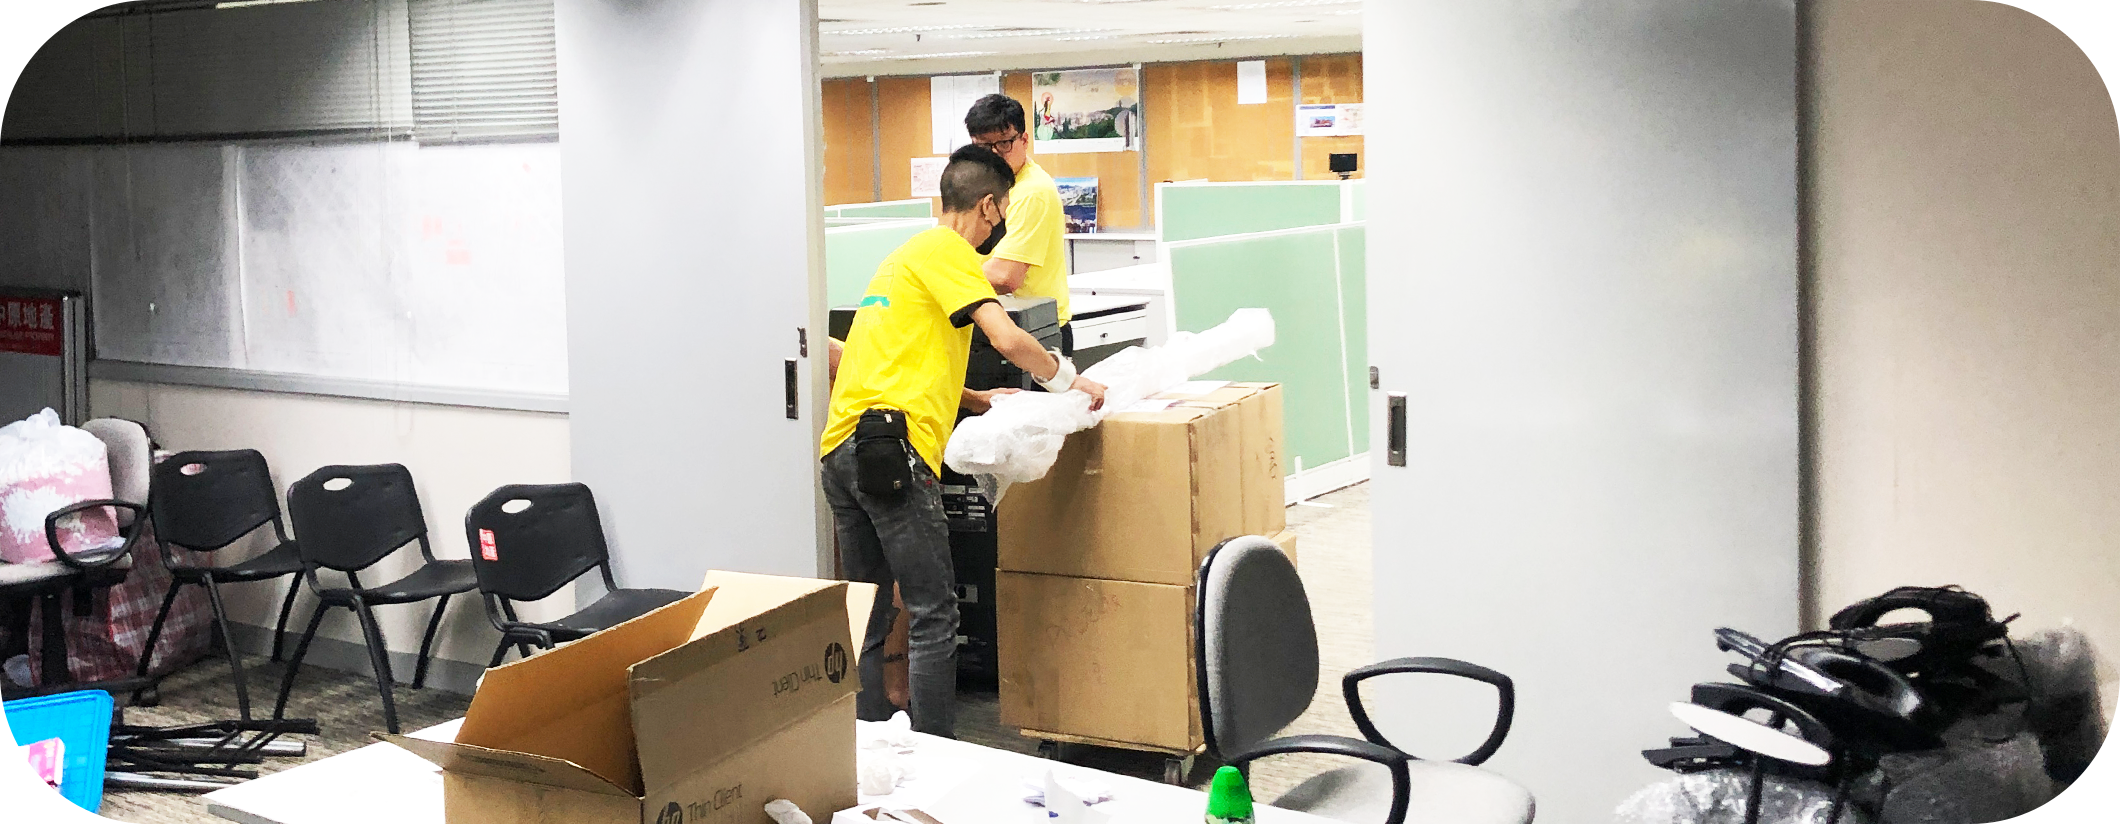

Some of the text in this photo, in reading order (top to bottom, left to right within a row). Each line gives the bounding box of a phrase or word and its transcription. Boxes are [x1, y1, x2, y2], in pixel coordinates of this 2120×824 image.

[771, 642, 847, 698] hp Thin Client
[687, 801, 711, 821] Thin
[713, 783, 742, 810] Client
